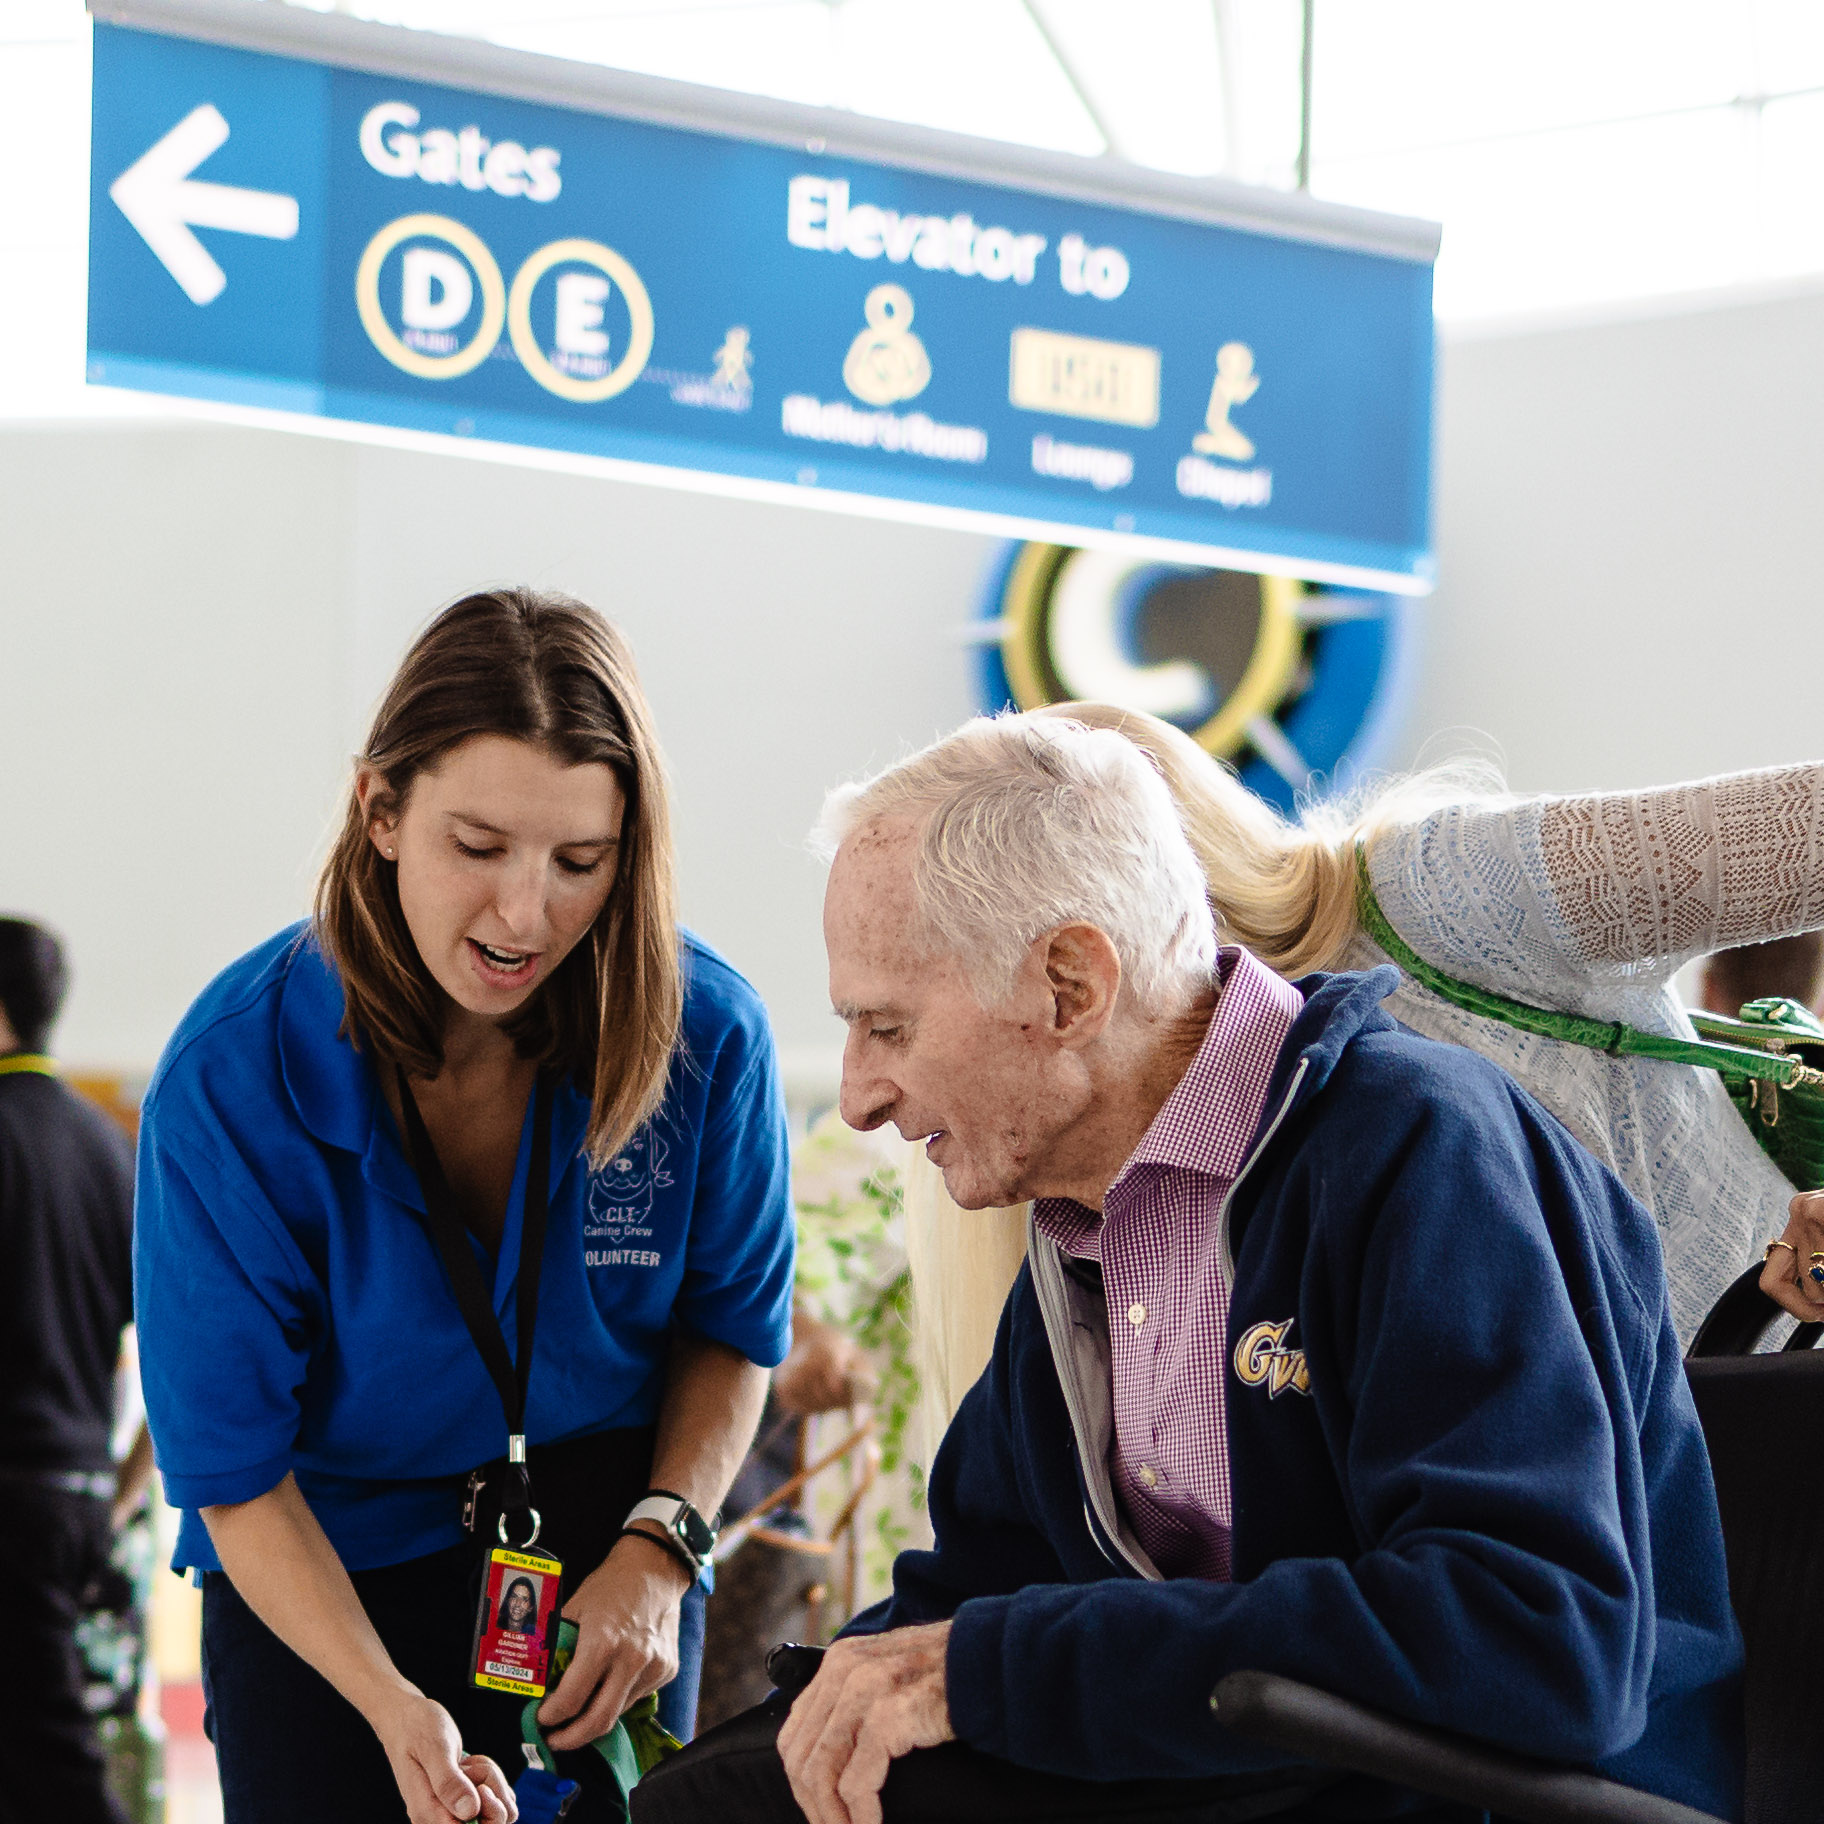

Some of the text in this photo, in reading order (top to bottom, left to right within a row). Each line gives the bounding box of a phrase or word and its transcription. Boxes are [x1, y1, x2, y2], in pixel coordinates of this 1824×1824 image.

[360, 101, 563, 203] Gates
[787, 174, 1130, 300] Elevator to
[401, 246, 474, 331] D
[555, 272, 611, 356] E
[606, 1207, 636, 1223] CLT
[584, 1224, 653, 1237] Canine Crew
[585, 1249, 661, 1267] OLUNTEER
[528, 1558, 551, 1571] Areas
[487, 1677, 534, 1694] Sterile Areas
